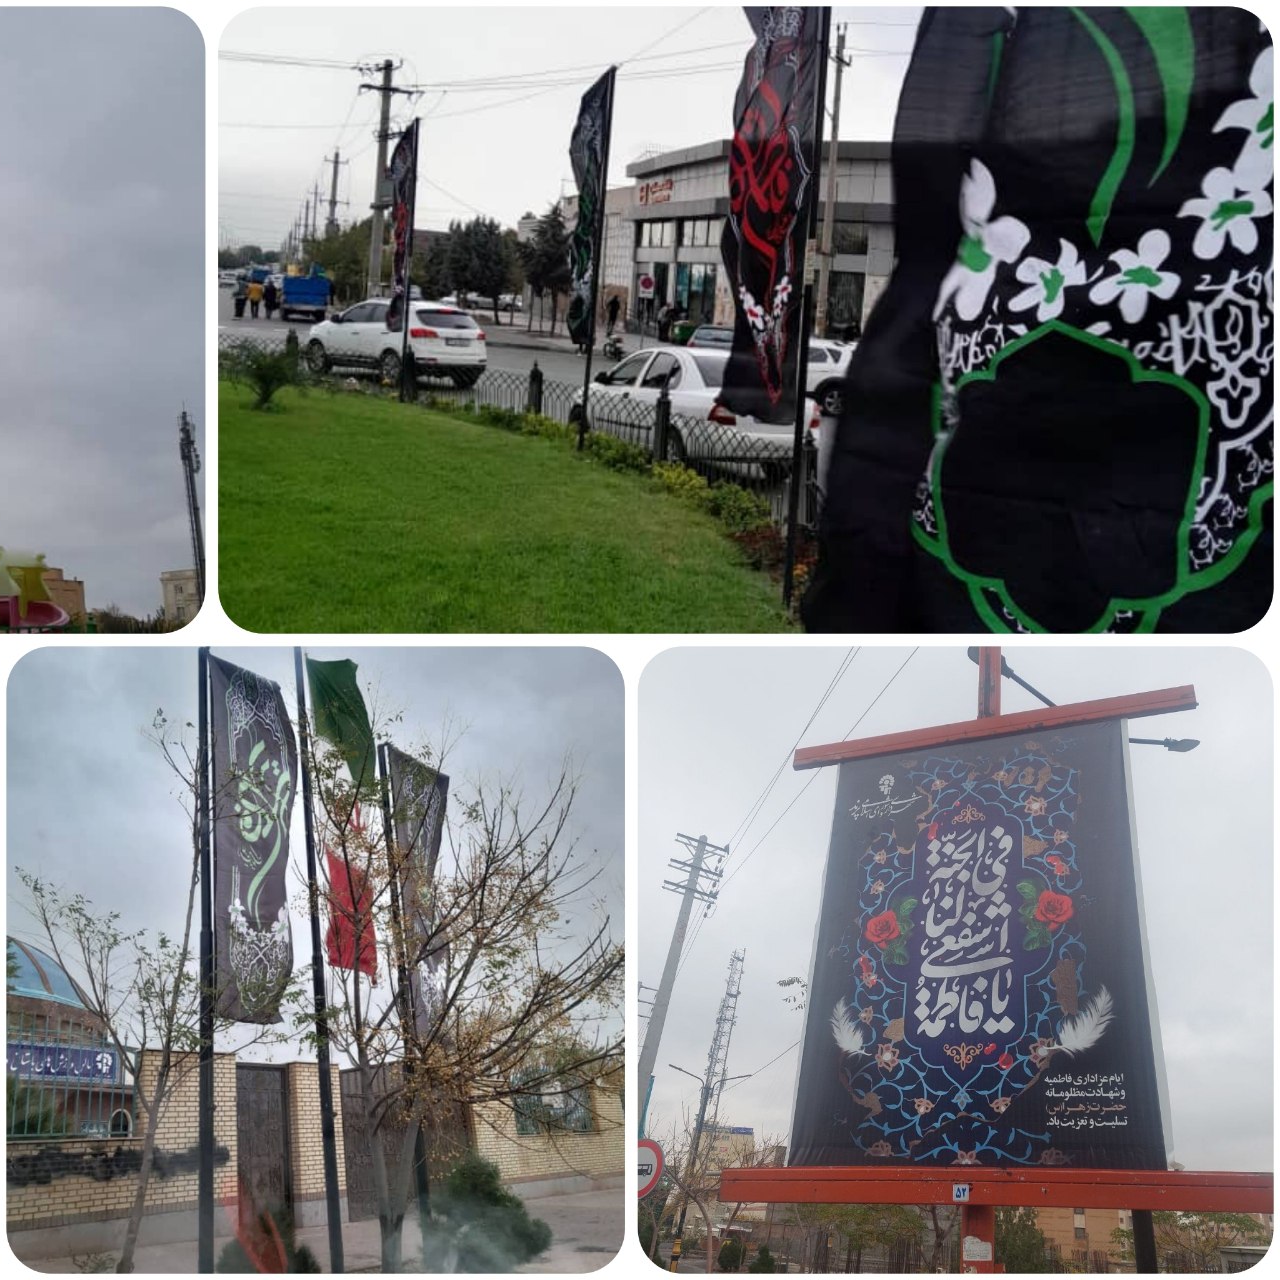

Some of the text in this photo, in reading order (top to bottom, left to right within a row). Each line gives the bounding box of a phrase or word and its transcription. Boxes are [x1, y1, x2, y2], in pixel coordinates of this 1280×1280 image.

[1044, 1073, 1072, 1086] فاطمیه
[1109, 1073, 1124, 1086] ایام
[1045, 1087, 1085, 1100] مظلومانه
[1085, 1087, 1120, 1100] شهادت
[1060, 1116, 1088, 1129] تعزیت
[1095, 1116, 1128, 1128] تسلیت
